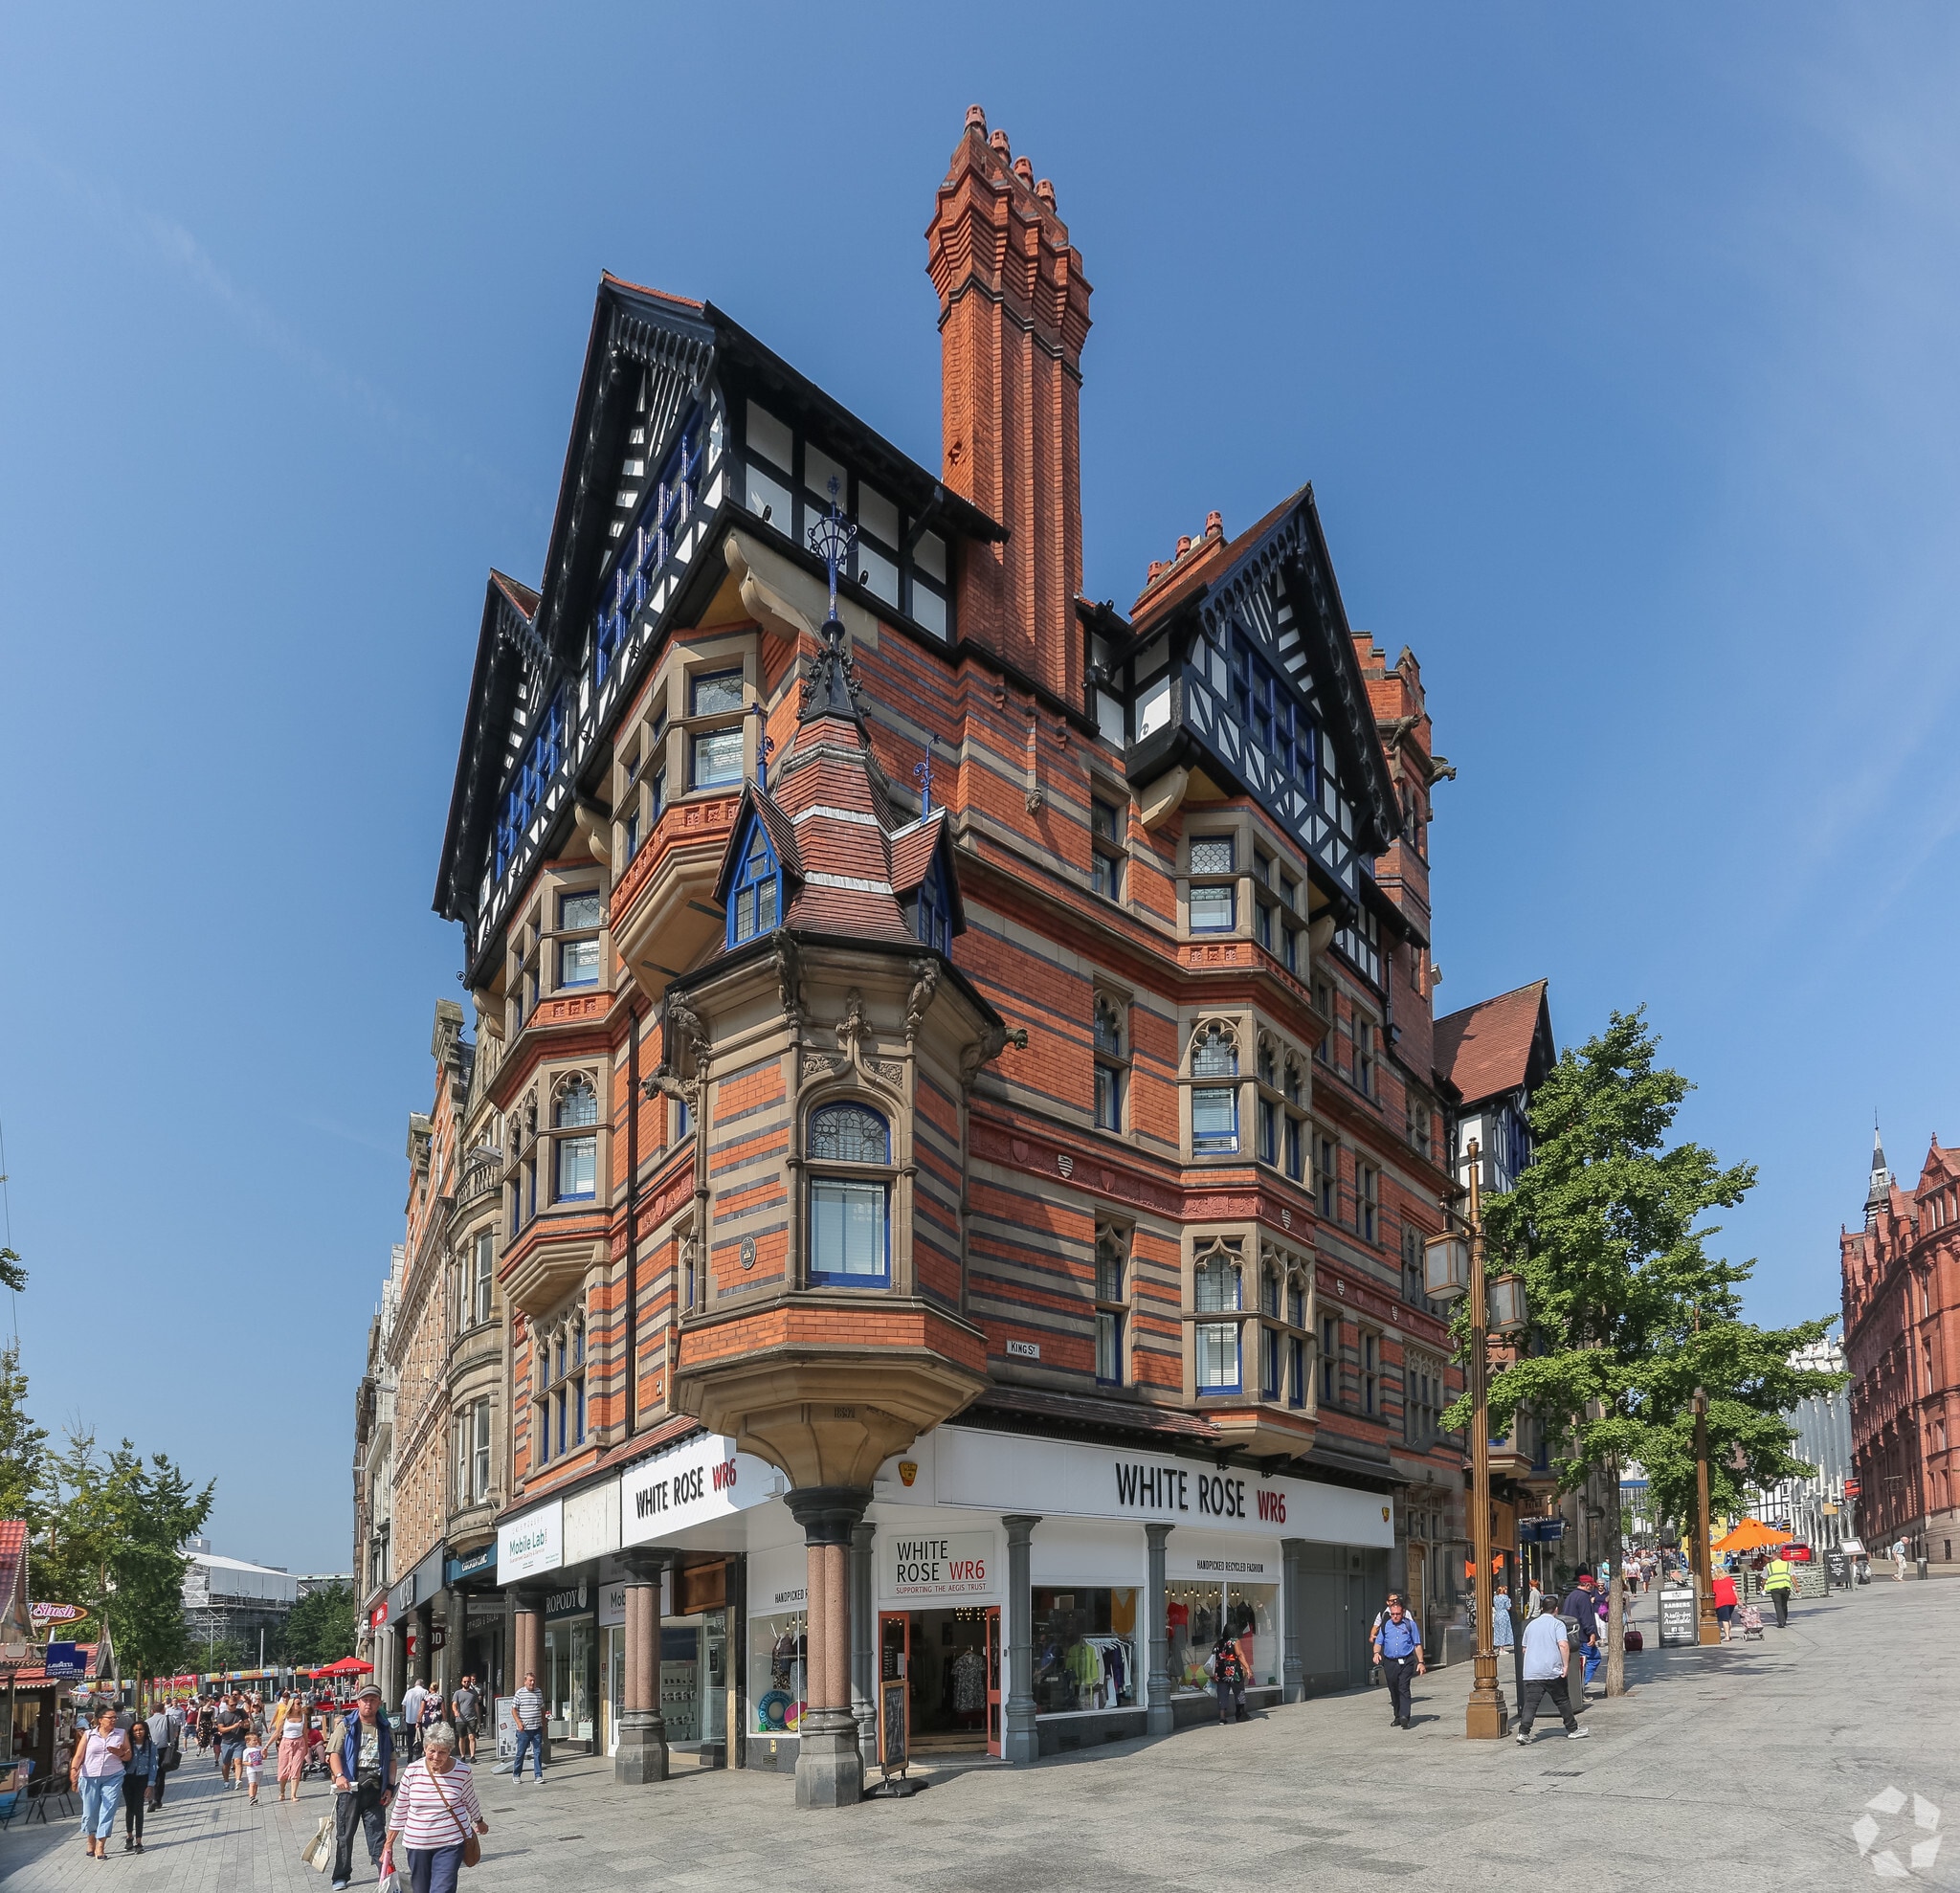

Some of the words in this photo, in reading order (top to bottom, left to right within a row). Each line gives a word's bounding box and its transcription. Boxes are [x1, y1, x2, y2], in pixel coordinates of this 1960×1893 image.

[1011, 1341, 1028, 1354] KING
[635, 1480, 669, 1520] WHITE
[674, 1466, 704, 1506] ROSE
[712, 1458, 737, 1492] WR6
[1115, 1462, 1189, 1510] WHITE
[1198, 1474, 1246, 1518] ROSE
[1257, 1489, 1286, 1524] WR6
[509, 1535, 531, 1556] Mobile
[532, 1528, 545, 1548] Lab
[897, 1540, 948, 1561] WHITE
[897, 1562, 940, 1583] ROSE
[948, 1560, 985, 1580] WR6
[1196, 1560, 1224, 1571] HANDPICKED
[1225, 1560, 1246, 1572] RECYCLED
[1246, 1562, 1264, 1573] FASHION
[774, 1589, 805, 1604] HANDPICKED
[896, 1585, 932, 1594] SUPPORTING
[33, 1602, 76, 1617] Slush
[546, 1590, 577, 1614] ROPODY
